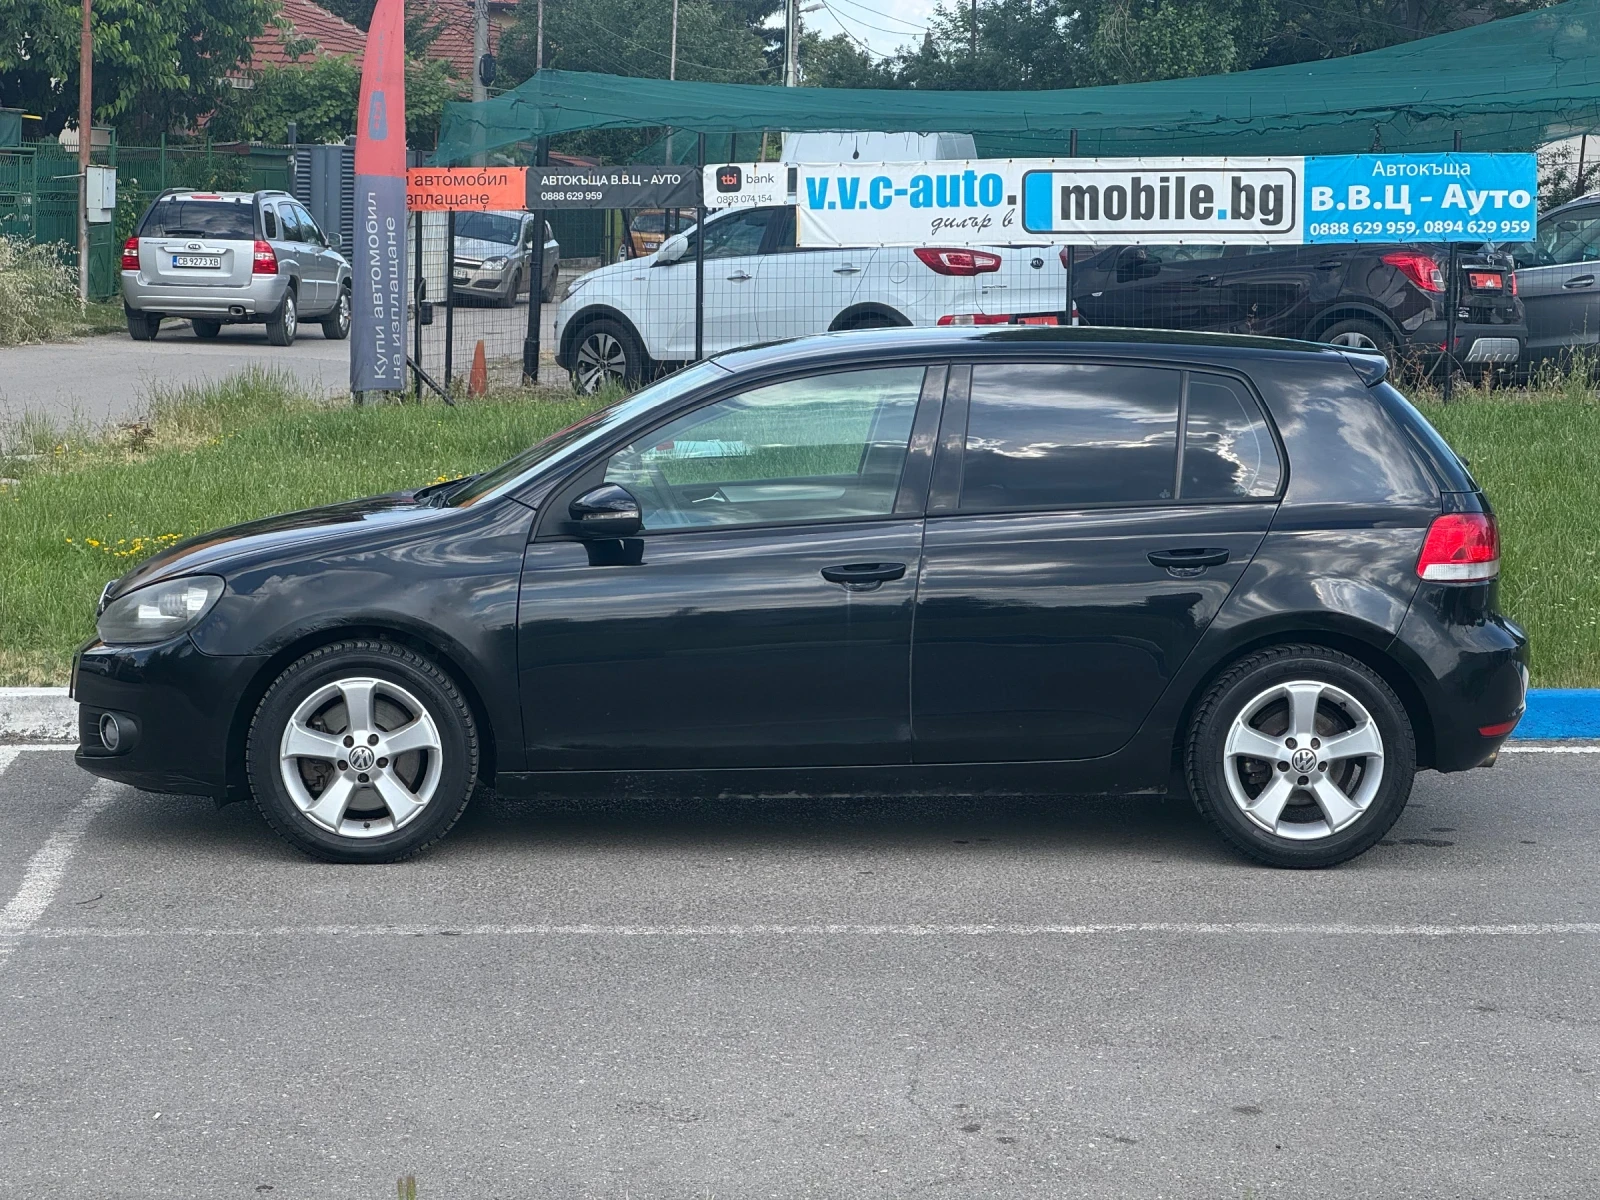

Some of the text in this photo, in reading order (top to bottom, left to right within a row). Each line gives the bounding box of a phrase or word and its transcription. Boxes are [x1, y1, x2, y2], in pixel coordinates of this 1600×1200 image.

[1371, 160, 1471, 178] Автокъща
[414, 172, 507, 187] автомобил
[541, 174, 608, 187] АВТОКЪЩА
[611, 174, 641, 187] В.В.Ц
[650, 174, 681, 185] АУТО
[721, 173, 737, 185] tbi
[746, 173, 775, 184] bank
[406, 192, 490, 206] зплащане
[541, 191, 603, 201] 0888 629 959
[716, 194, 773, 204] 0893 074 154
[1060, 175, 1284, 226] mobile.bg
[1311, 184, 1412, 215] В.В.Ц
[1441, 183, 1531, 216] Ауто
[931, 213, 993, 235] дилър
[1309, 222, 1349, 235] 0888
[1352, 222, 1382, 235] 629
[1423, 220, 1464, 234] 0894
[1467, 220, 1497, 233] 629
[1501, 220, 1531, 233] 959
[189, 258, 208, 266] 9273
[365, 192, 388, 379] Купи автомобил
[386, 216, 402, 380] на изплащане
